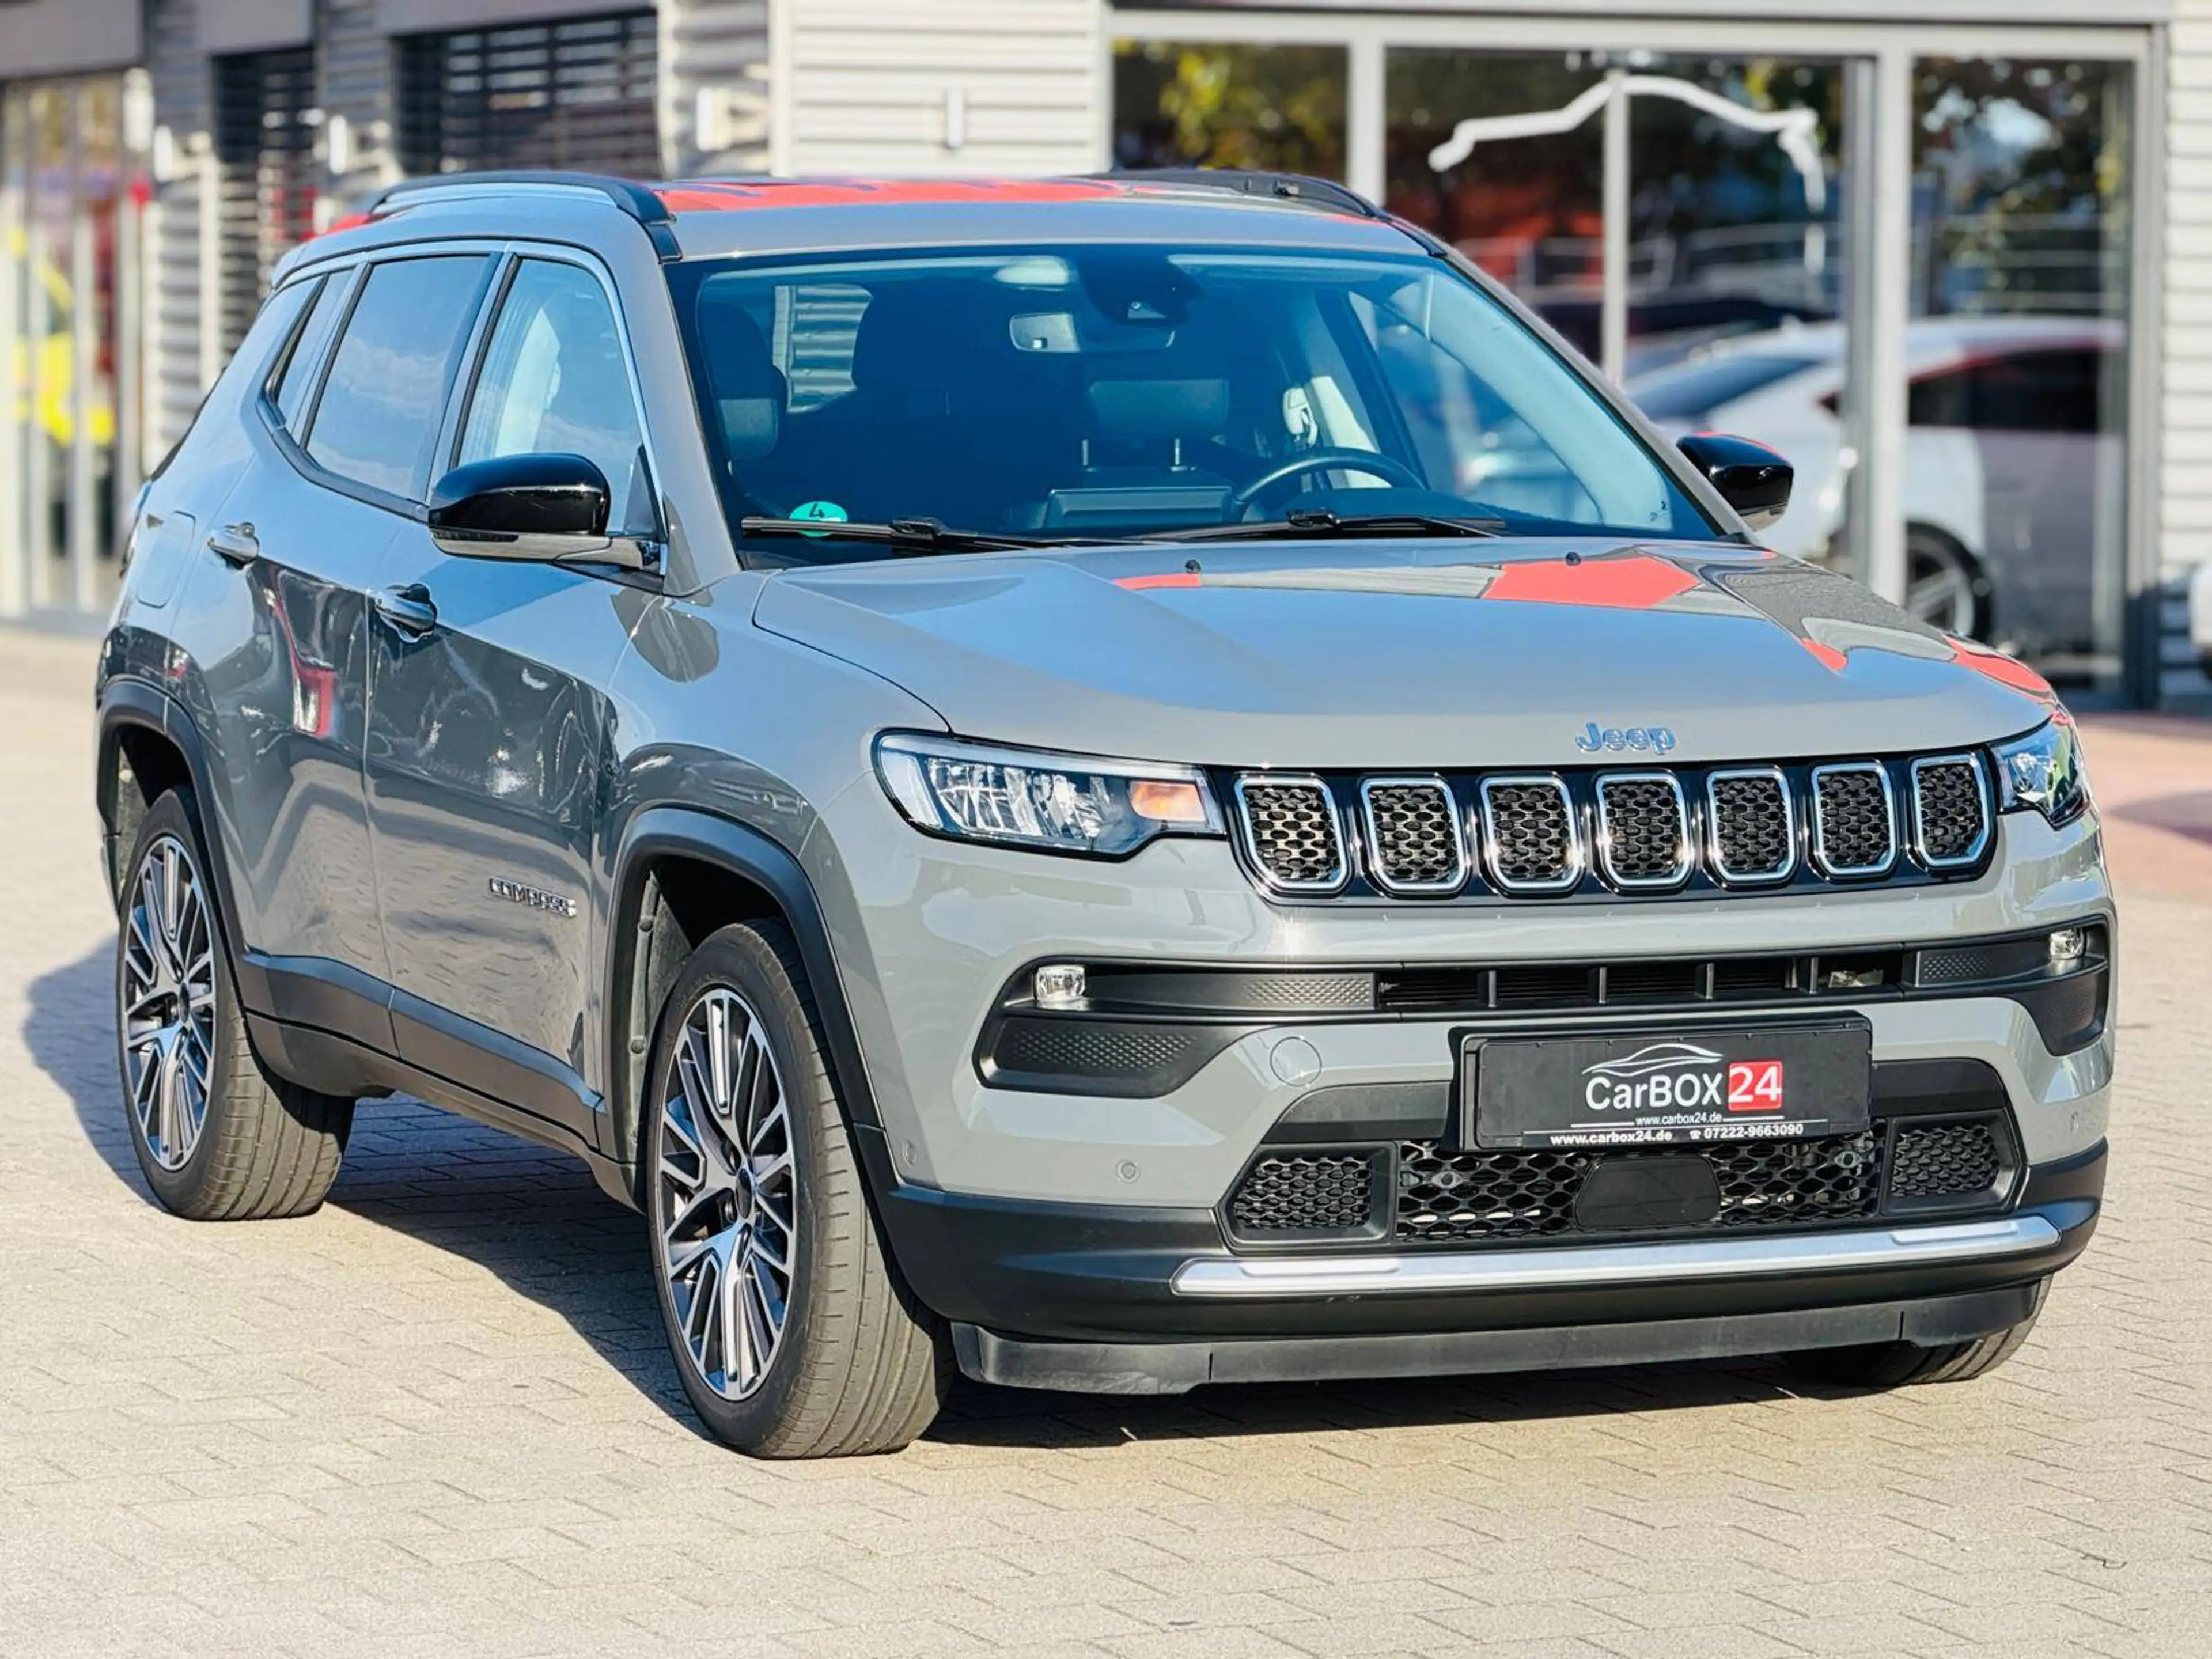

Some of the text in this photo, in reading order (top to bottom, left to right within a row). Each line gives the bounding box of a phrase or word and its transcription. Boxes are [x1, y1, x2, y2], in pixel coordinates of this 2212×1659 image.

[1575, 722, 1676, 756] Jeep
[1635, 1112, 1723, 1126] www.carbox24.de
[1550, 1124, 1804, 1145] www.carbox24.de 07222-9663090
